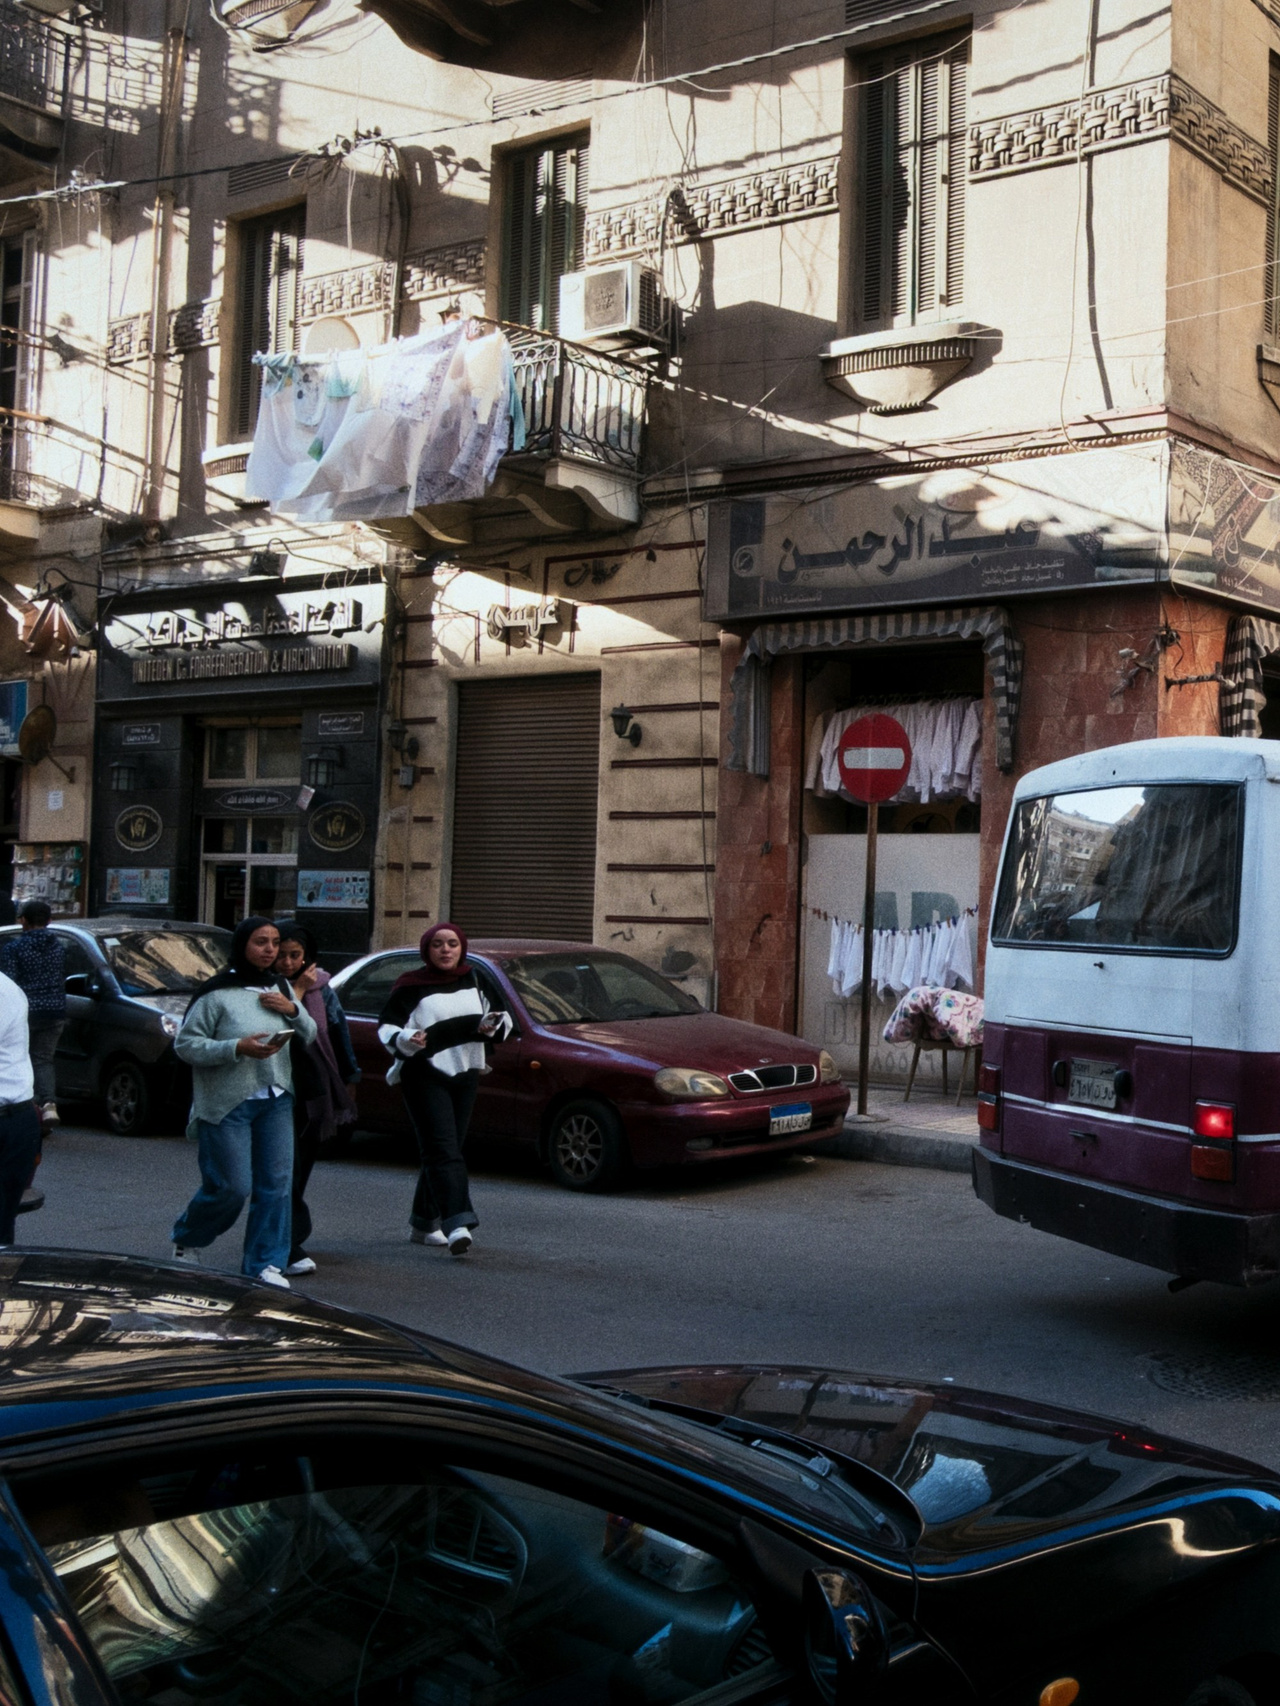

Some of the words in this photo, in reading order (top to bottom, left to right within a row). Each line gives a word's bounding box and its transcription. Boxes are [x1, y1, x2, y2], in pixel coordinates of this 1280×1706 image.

[776, 513, 926, 586] الرحمن
[271, 649, 279, 673] &
[281, 643, 349, 673] AIRCONDITION
